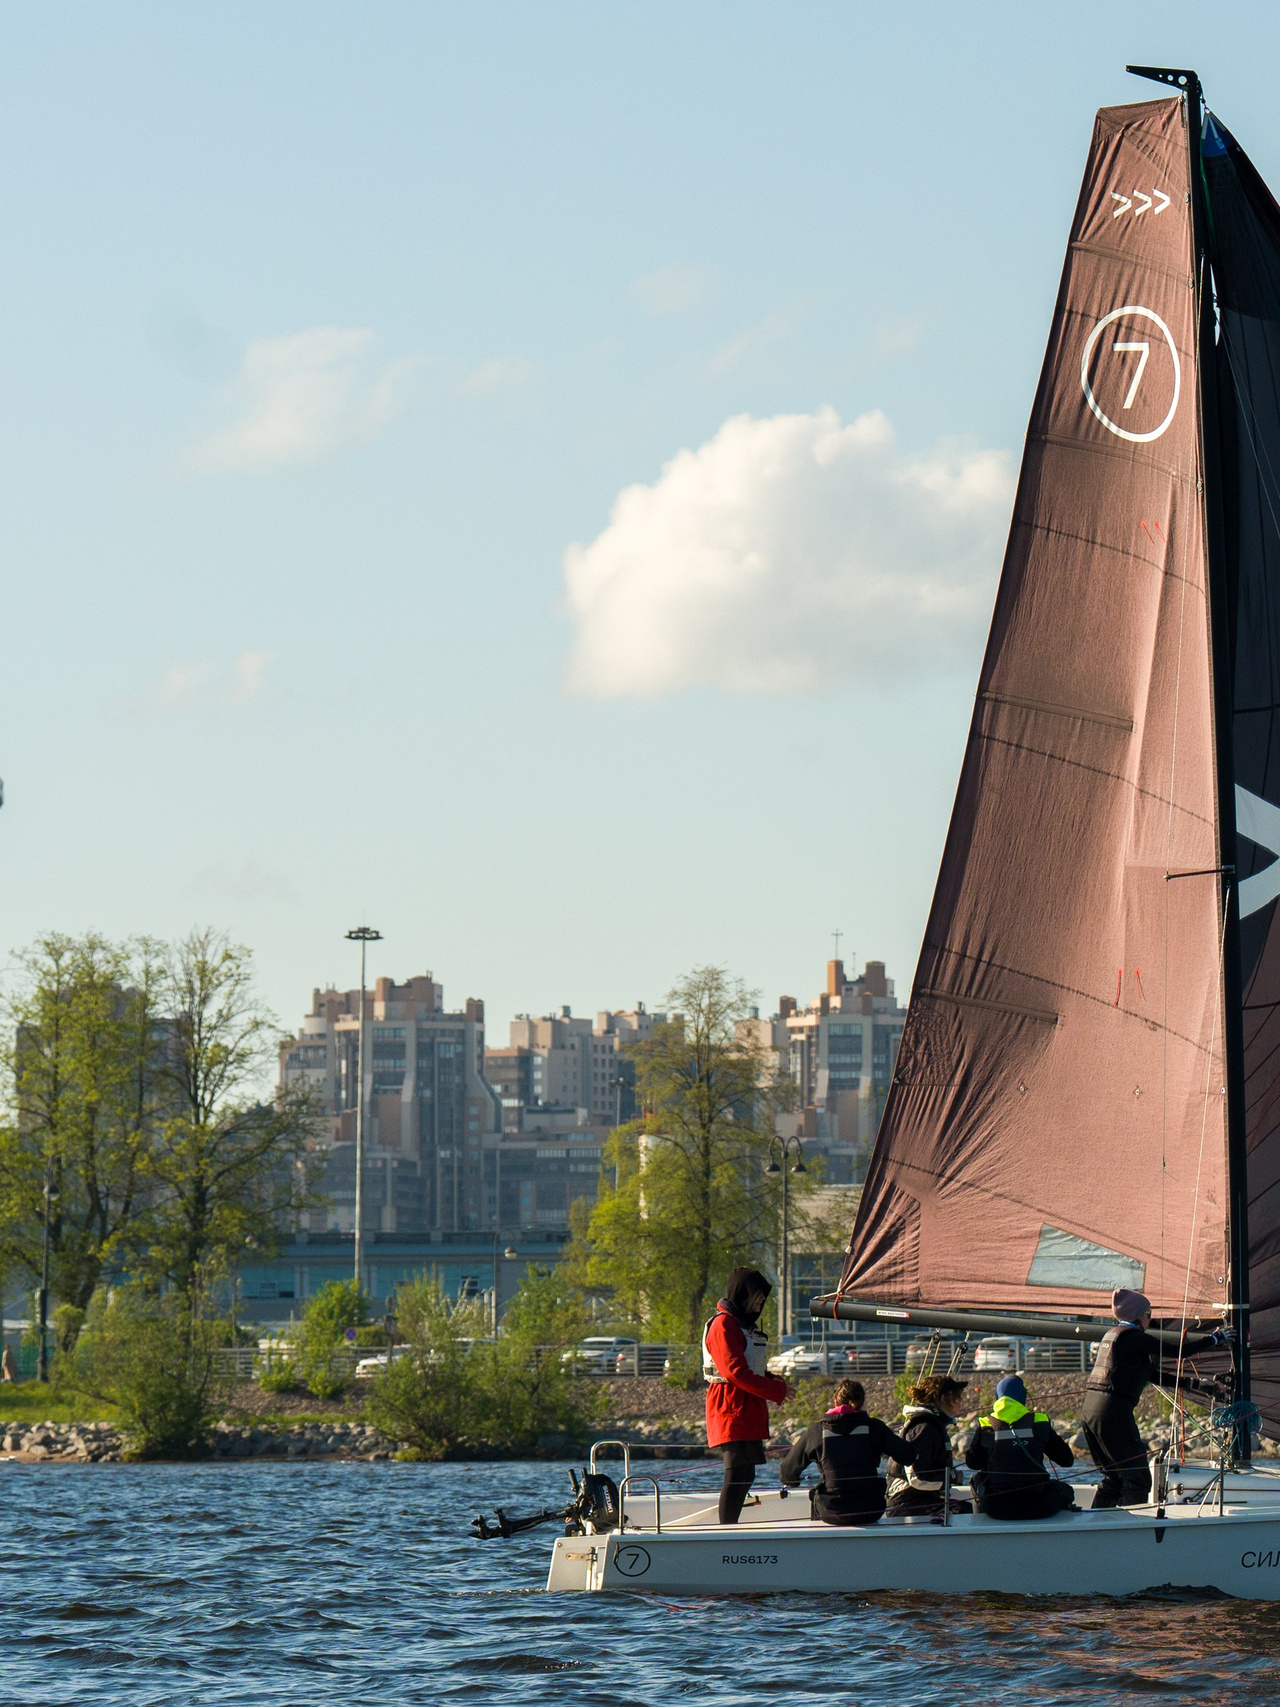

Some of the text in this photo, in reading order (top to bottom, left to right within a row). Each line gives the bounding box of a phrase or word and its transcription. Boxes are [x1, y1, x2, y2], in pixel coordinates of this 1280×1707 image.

[1113, 342, 1150, 410] 7
[603, 1484, 614, 1514] SUZUKI
[626, 1553, 640, 1570] 7
[722, 1555, 778, 1564] RUS6173
